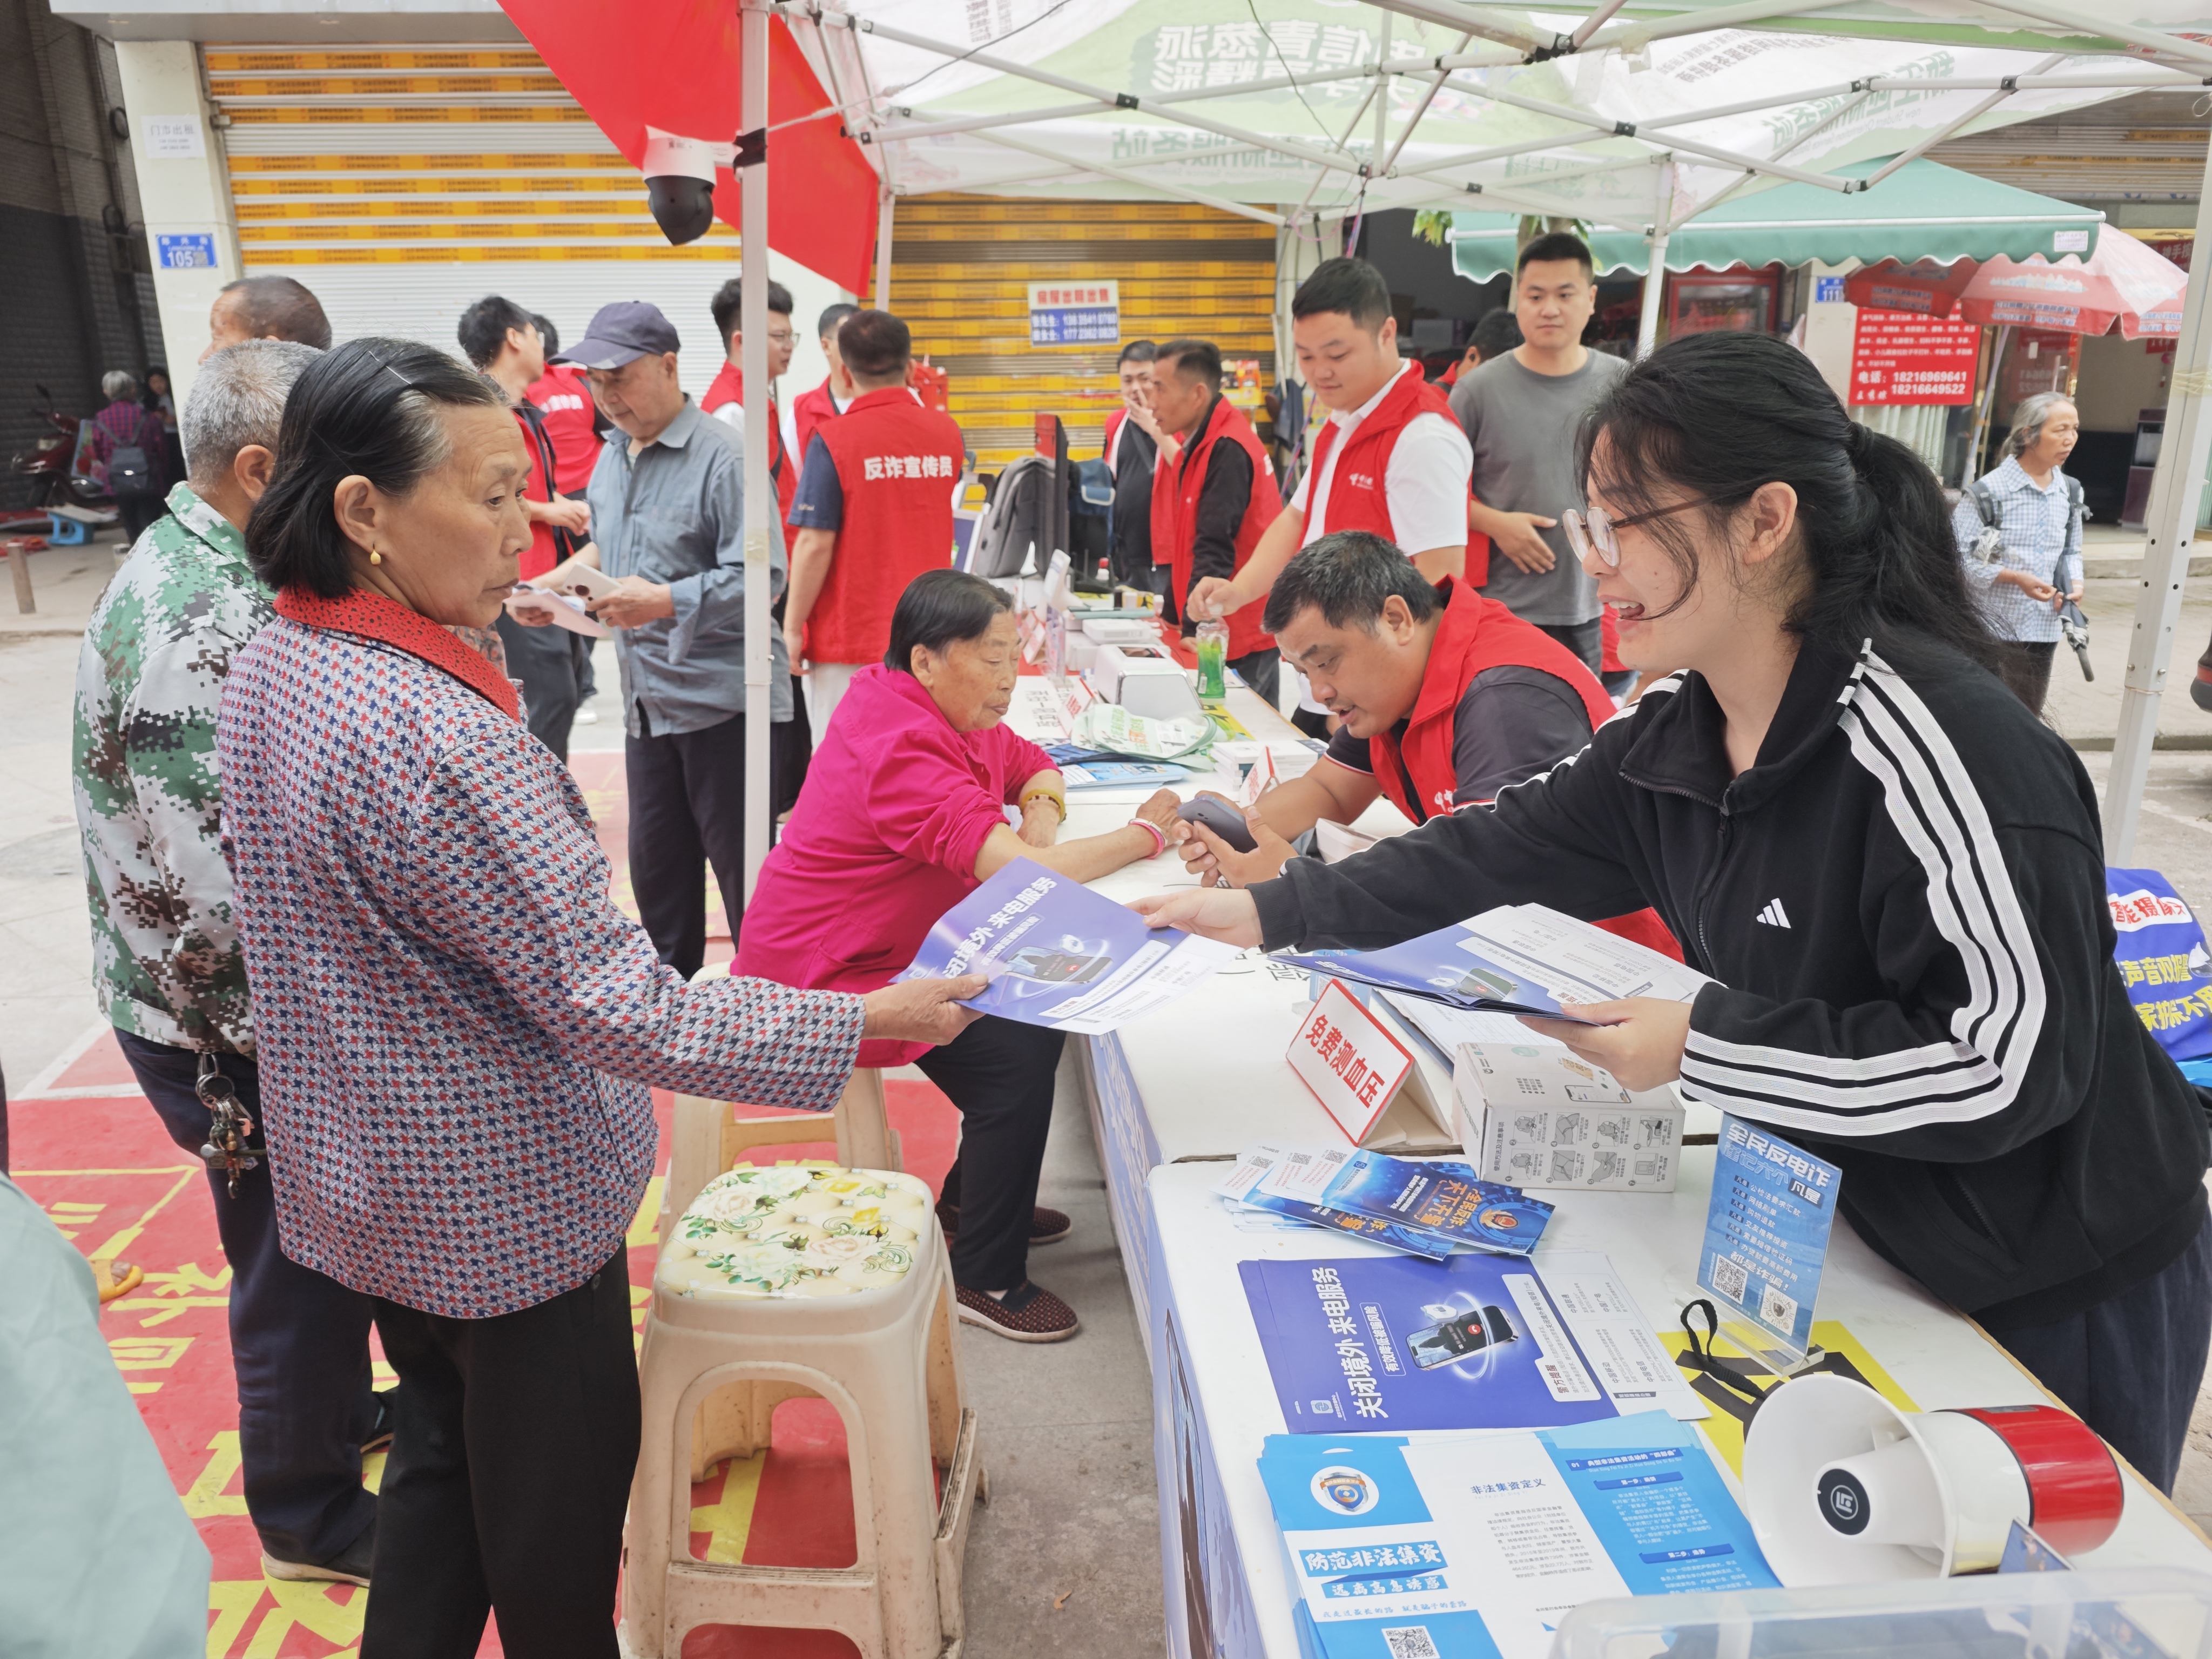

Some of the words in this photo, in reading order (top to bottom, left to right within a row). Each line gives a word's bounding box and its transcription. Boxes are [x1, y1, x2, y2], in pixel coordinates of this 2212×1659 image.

[168, 250, 193, 267] 105
[864, 455, 953, 481] 反诈宣传员
[988, 876, 1058, 929] 来电服务
[1305, 1014, 1385, 1109] 免费测血压
[1493, 1121, 1504, 1171] 使用方法及注意事项
[1727, 1123, 1831, 1188] 全民反电诈
[1724, 1142, 1789, 1186] 谨记六个
[1791, 1181, 1822, 1205] 凡是
[1419, 1175, 1468, 1231] 天下无骗
[1449, 1190, 1483, 1229] 全民反诈
[1748, 1196, 1777, 1217] 网络刷单
[1750, 1184, 1801, 1217] 公检法要求汇款
[1745, 1219, 1788, 1249] 交友推荐投资
[1746, 1208, 1776, 1229] 购物退款
[1741, 1244, 1798, 1282] 办贷款要高额费用
[1743, 1232, 1793, 1266] 索要短信验证码
[1730, 1251, 1789, 1292] 都是诈骗！
[1311, 1267, 1357, 1334] 来电服务
[1560, 1293, 1579, 1314] 中国联通
[1593, 1292, 1611, 1312] 中国广电
[1365, 1305, 1400, 1373] 有效降低被骗风险
[1336, 1338, 1389, 1419] 关闭境外
[1543, 1363, 1570, 1394] 警方提醒
[1601, 1361, 1621, 1384] 中国移动
[1634, 1360, 1656, 1382] 中国电信
[1471, 1479, 1546, 1494] 非法集资定义
[1305, 1543, 1442, 1571] 防范非法集资
[1332, 1576, 1440, 1596] 远离高息诱惑
